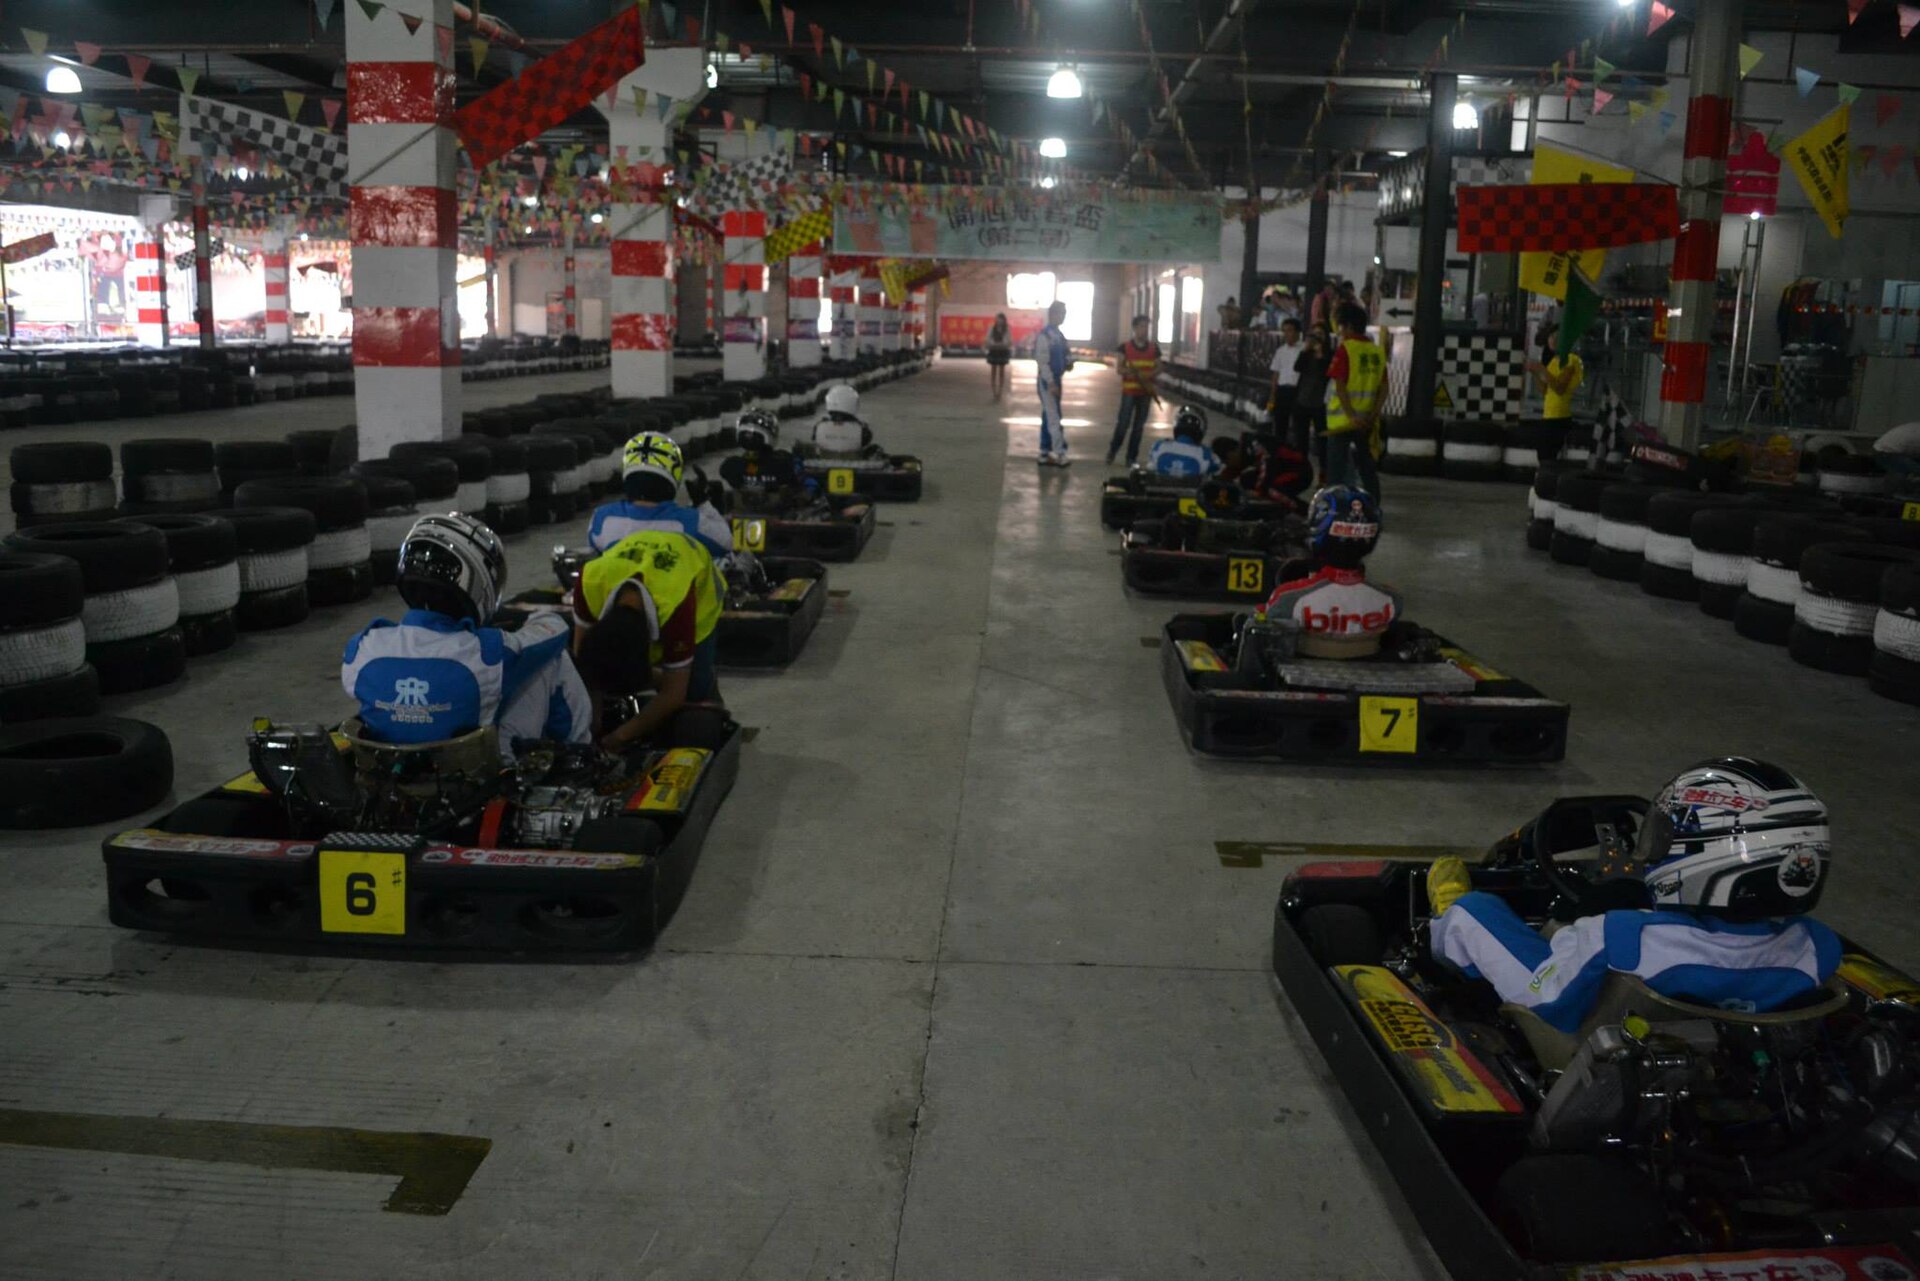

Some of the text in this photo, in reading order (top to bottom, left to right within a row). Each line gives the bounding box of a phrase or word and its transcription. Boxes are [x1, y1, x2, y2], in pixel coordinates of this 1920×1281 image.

[734, 519, 762, 545] 10
[1231, 562, 1260, 589] 13
[1303, 603, 1391, 632] birel
[1381, 708, 1401, 738] 7
[346, 872, 376, 916] 6
